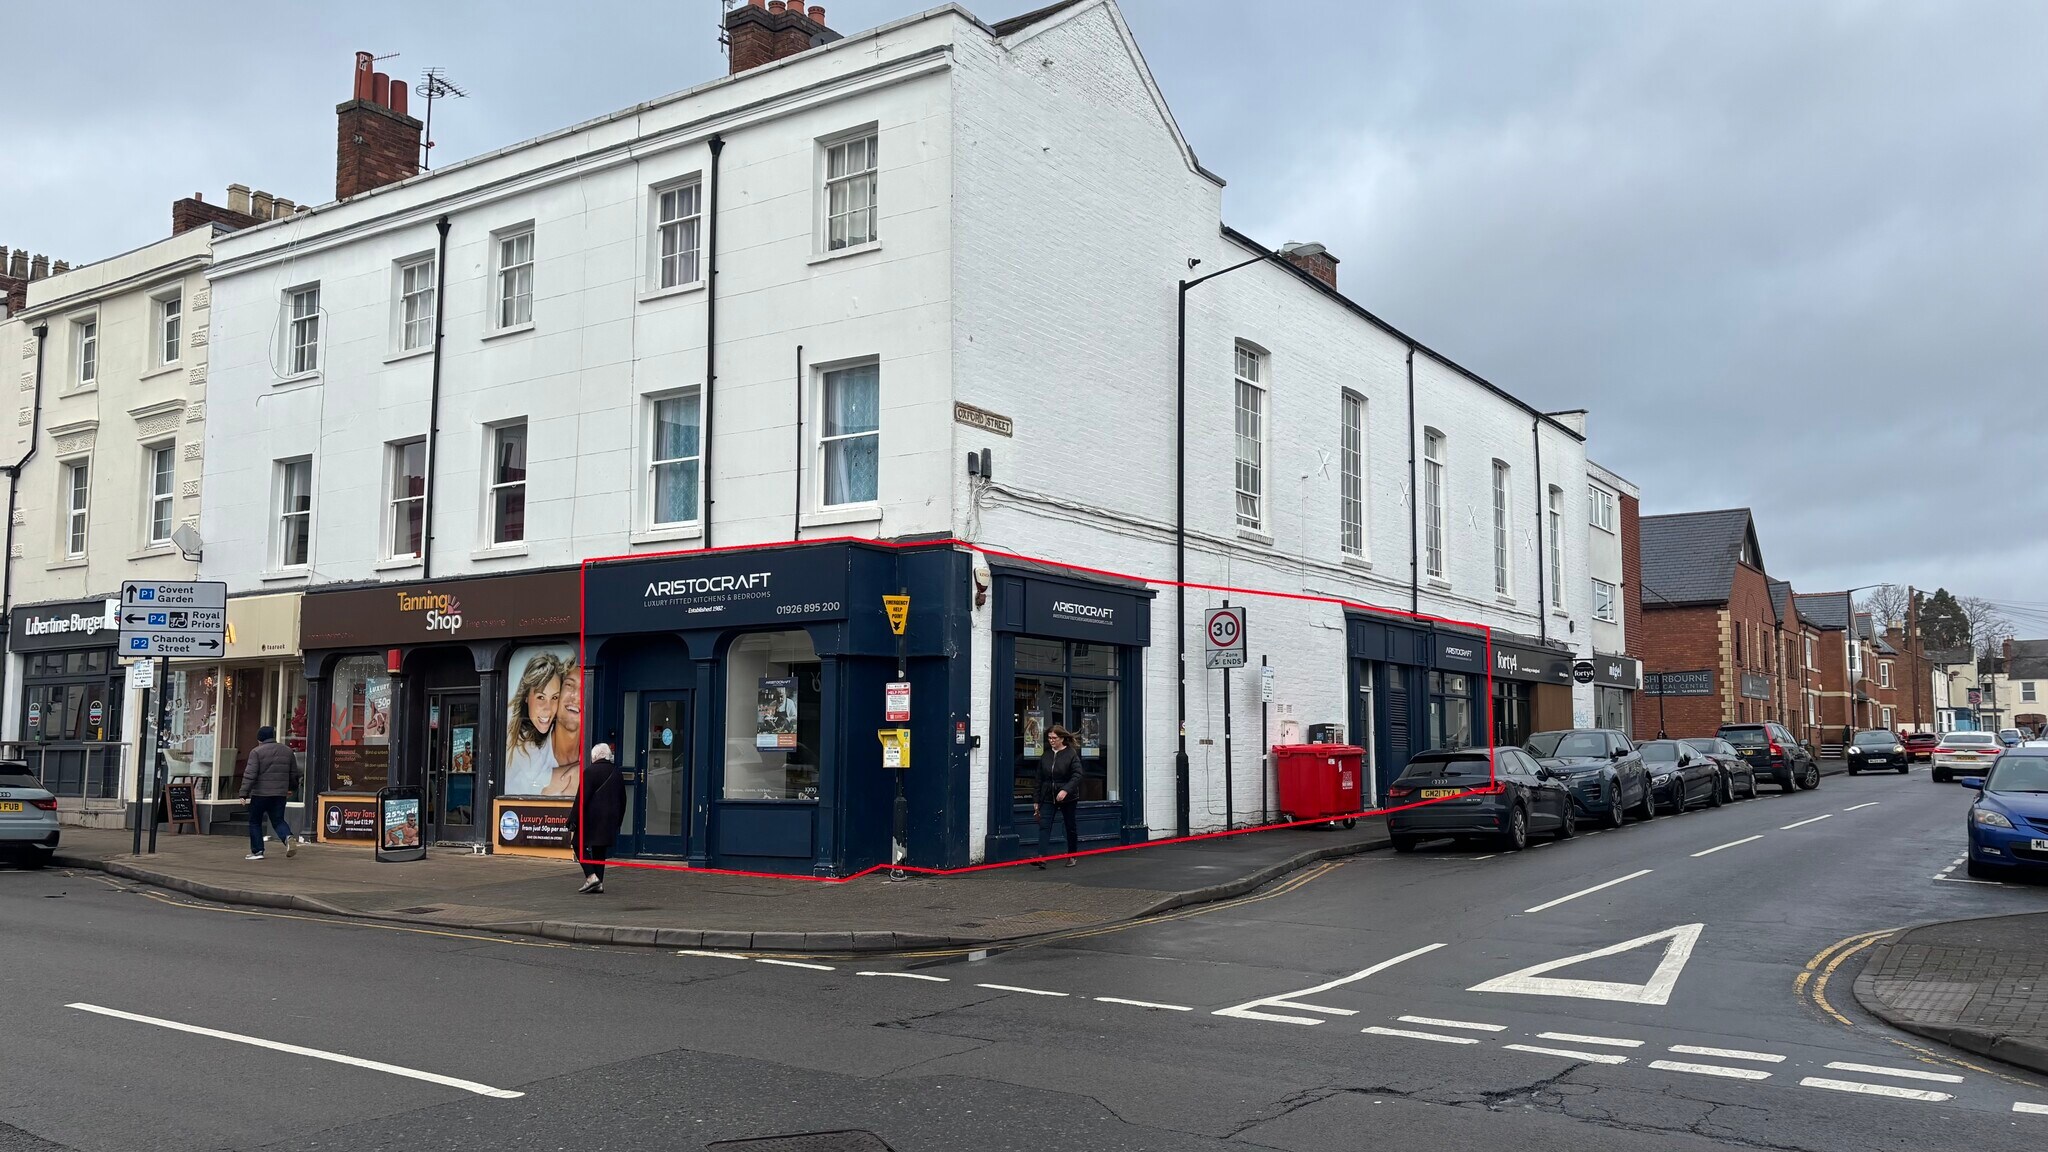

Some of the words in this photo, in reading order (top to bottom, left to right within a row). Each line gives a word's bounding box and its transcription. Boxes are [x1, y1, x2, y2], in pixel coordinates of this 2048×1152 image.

[957, 408, 983, 424] OXFORD
[986, 416, 1010, 431] STREET
[158, 585, 194, 594] Covent
[644, 572, 771, 597] ARISTOCRAFT
[157, 595, 194, 603] Garden
[397, 590, 448, 614] Tanning
[693, 595, 726, 603] KITCHENS
[733, 591, 771, 599] BEDROOMS
[776, 604, 802, 615] 01926
[803, 603, 821, 613] 895
[822, 601, 840, 611] 200
[1052, 600, 1114, 619] ARISTOCRAFT
[192, 611, 220, 620] Royal
[25, 615, 70, 636] Libertine
[70, 613, 105, 635] Burger
[191, 620, 220, 628] Priors
[426, 609, 463, 635] Shop
[1213, 621, 1236, 637] 30
[152, 635, 196, 643] Chandos
[157, 644, 190, 652] Street
[1446, 646, 1472, 657] ARISTOCRAFT
[1497, 650, 1517, 675] forty4
[1574, 669, 1594, 678] forty4
[370, 683, 390, 693] LUXURY
[1425, 789, 1440, 797] GM21
[1443, 789, 1456, 797] TYA
[344, 809, 361, 819] Spray
[406, 806, 418, 815] off
[520, 814, 543, 825] Luxury
[544, 814, 568, 824] Tannin
[541, 825, 550, 833] 50p
